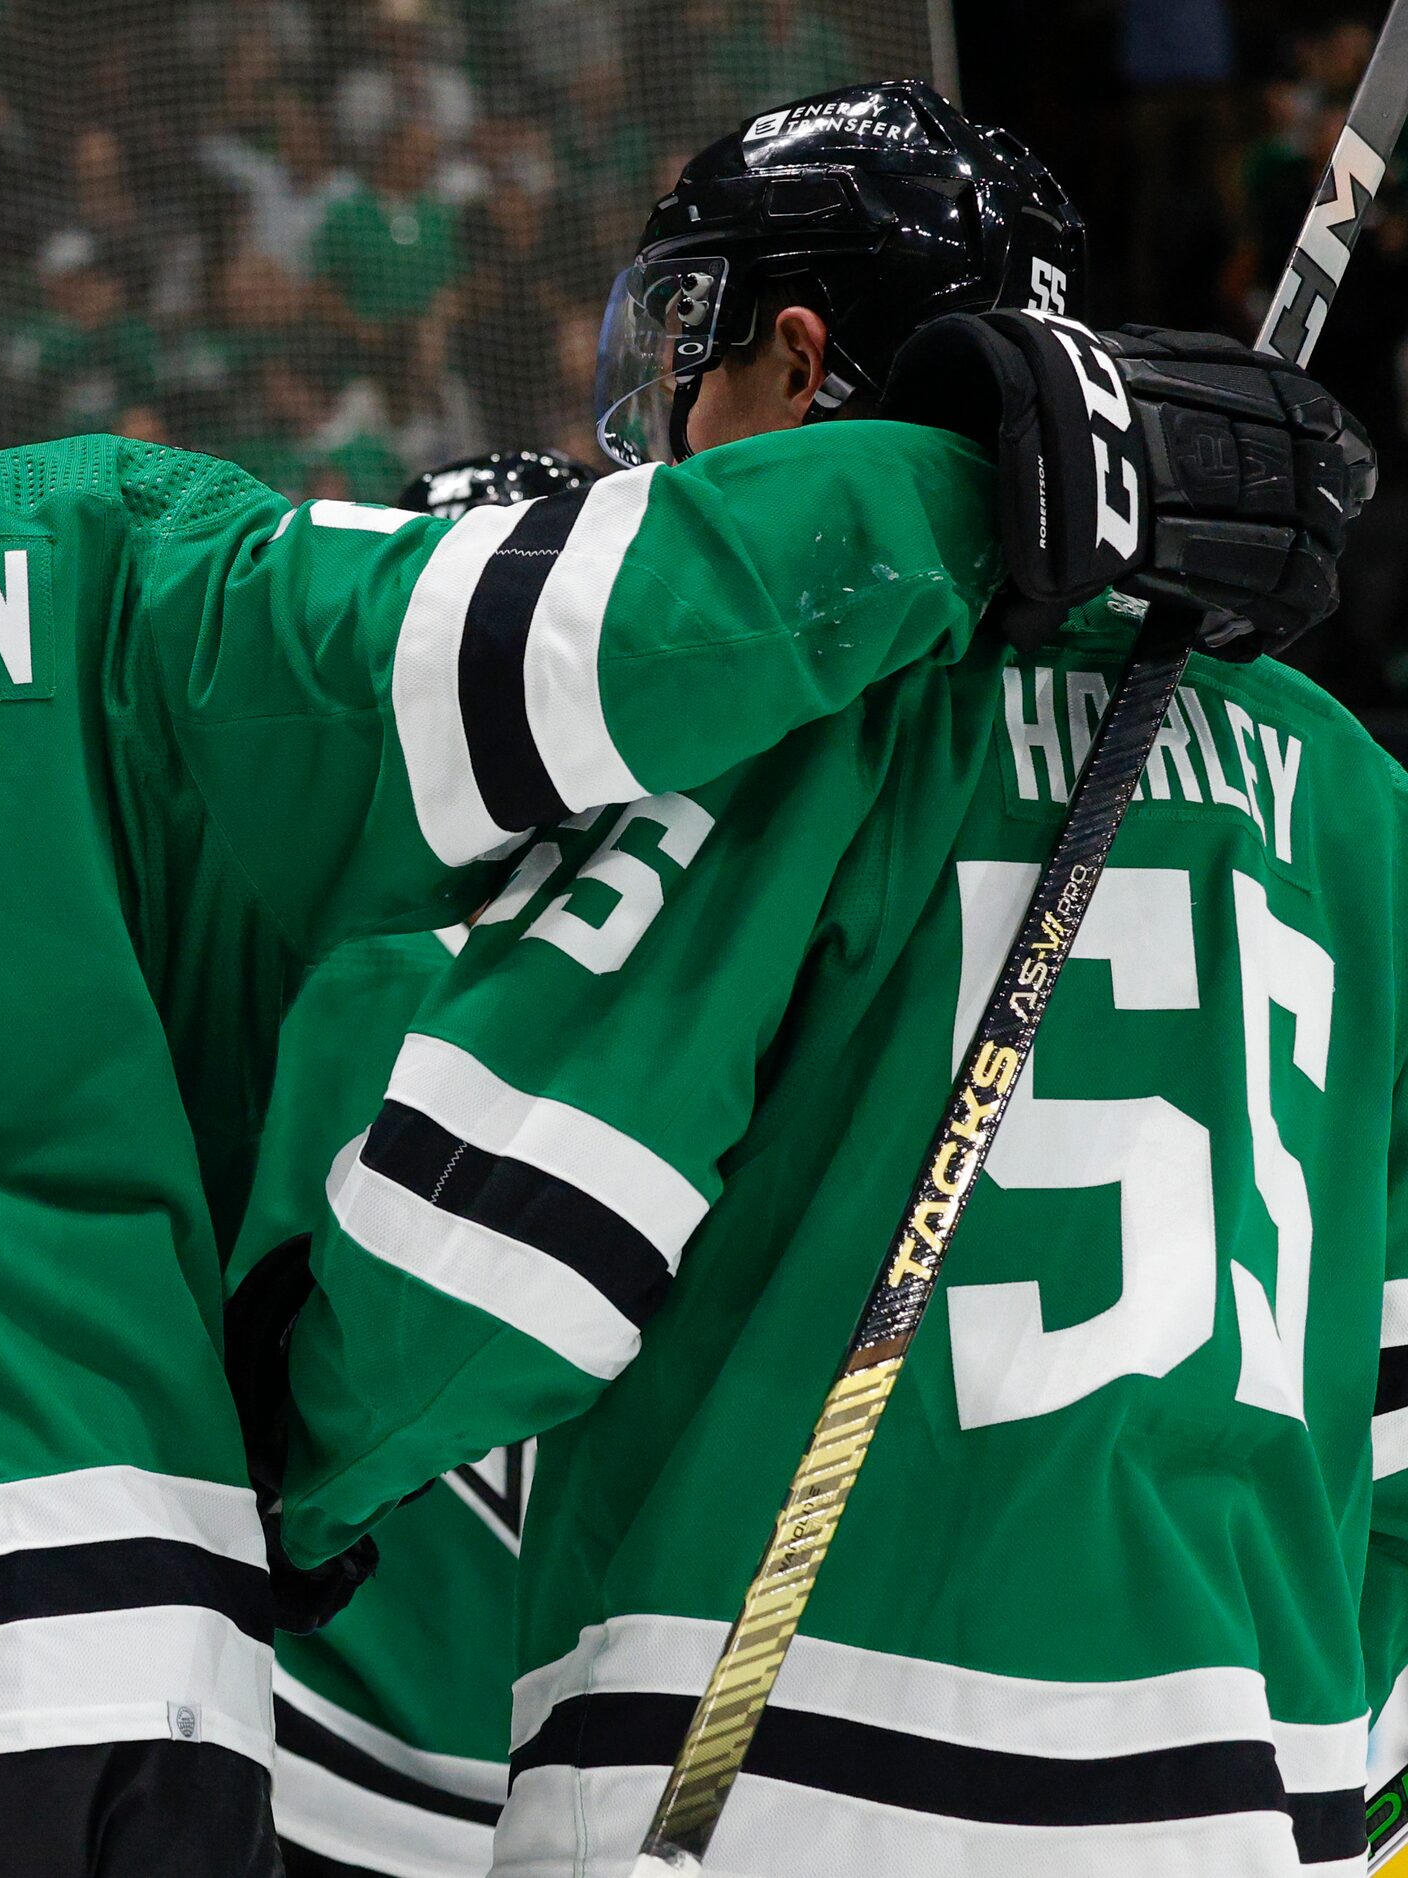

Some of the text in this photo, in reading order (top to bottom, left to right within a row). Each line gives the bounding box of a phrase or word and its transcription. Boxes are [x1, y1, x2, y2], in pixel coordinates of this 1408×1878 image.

[1027, 255, 1067, 317] 55
[1037, 455, 1046, 549] ROBERTSON
[889, 1040, 1019, 1288] TACKS
[948, 861, 1336, 1431] 55
